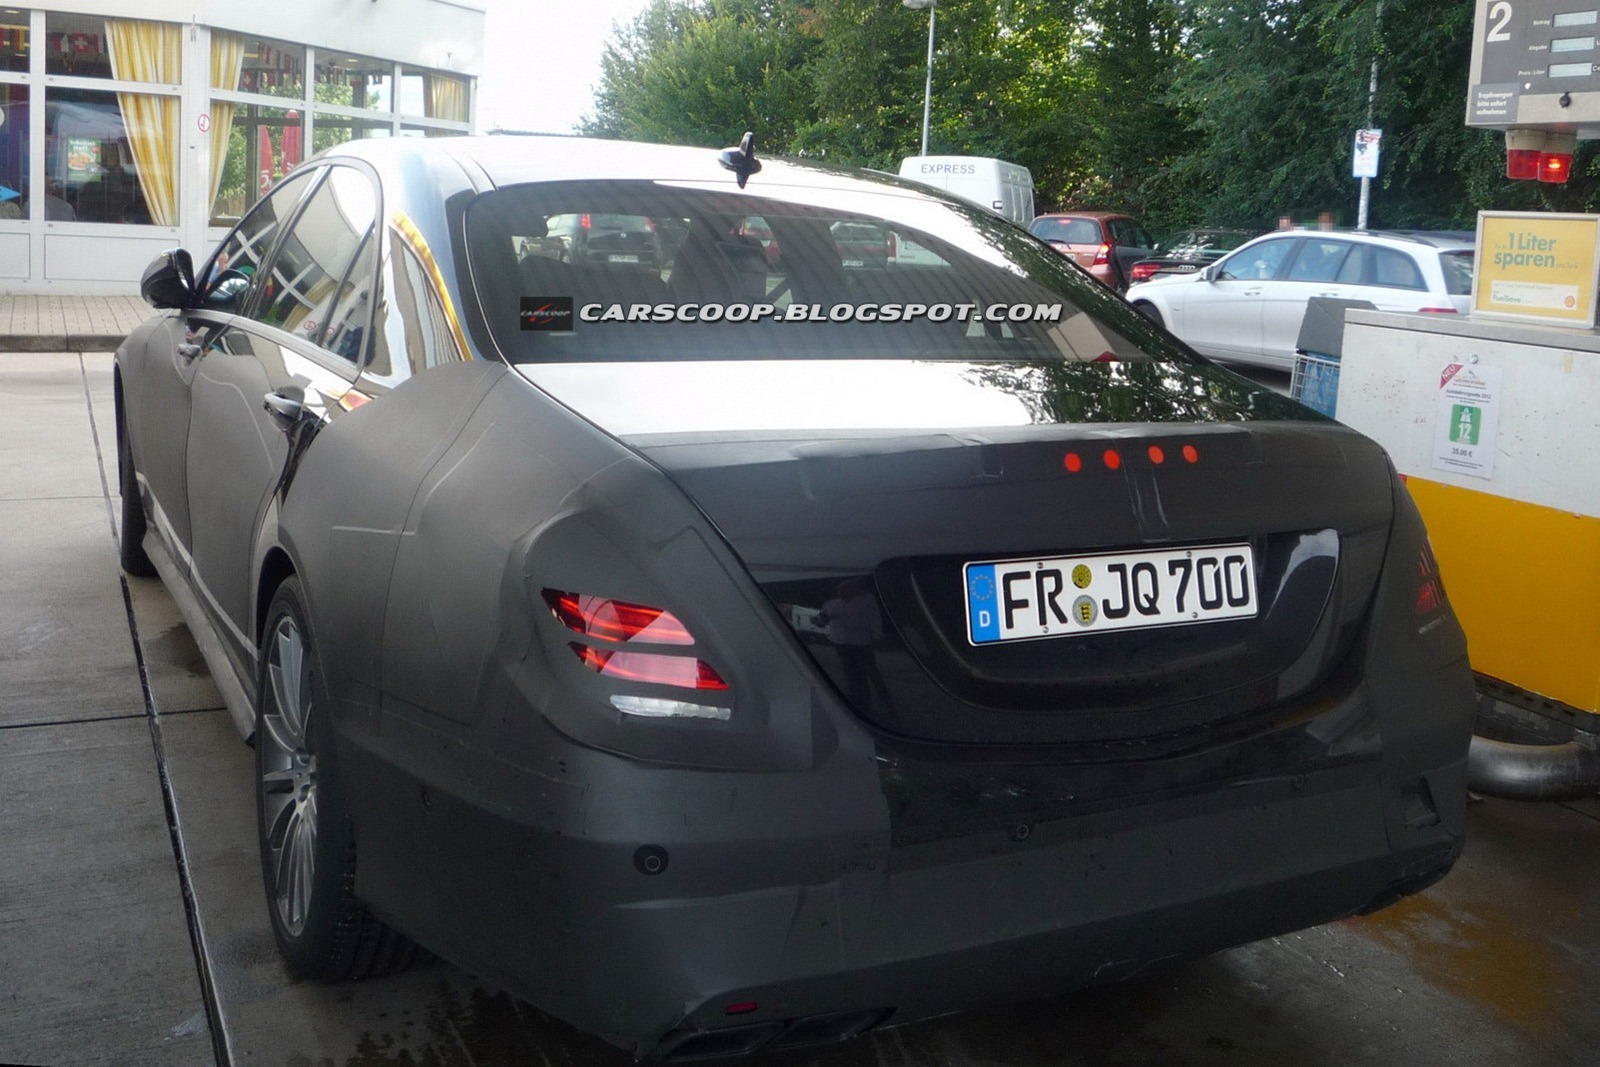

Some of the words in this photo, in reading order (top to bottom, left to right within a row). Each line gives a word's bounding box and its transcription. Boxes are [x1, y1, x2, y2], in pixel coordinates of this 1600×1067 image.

[1487, 1, 1512, 42] 2
[921, 164, 975, 174] EXPRESS
[1509, 232, 1515, 250] 1
[1518, 232, 1556, 251] Liter
[1494, 252, 1556, 270] sparen
[1442, 365, 1456, 379] NEU
[1459, 422, 1472, 440] 12
[1001, 568, 1068, 630] FR
[1101, 562, 1161, 619] JQ
[1167, 555, 1250, 613] 700
[979, 610, 990, 627] D
